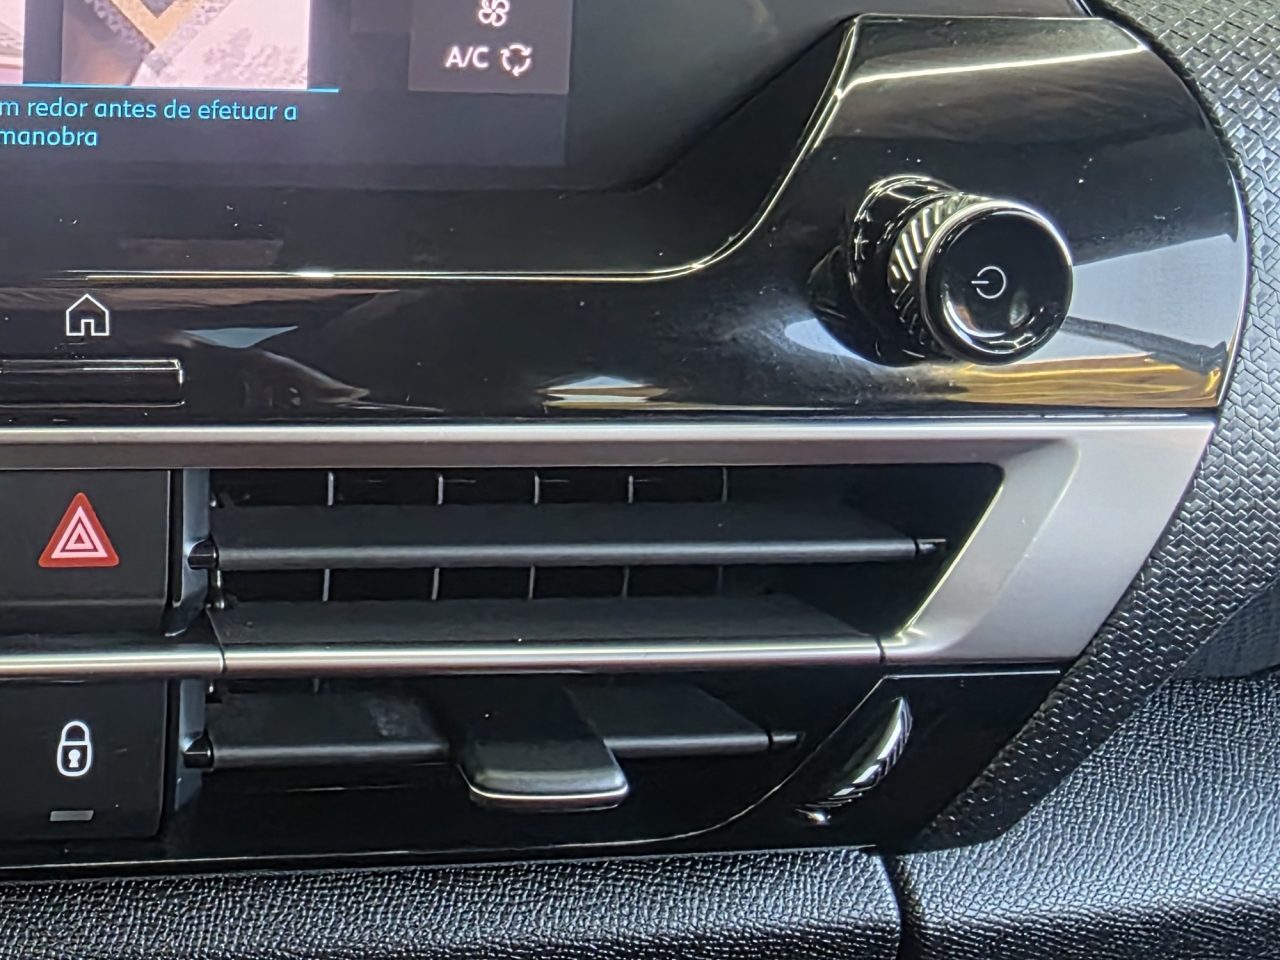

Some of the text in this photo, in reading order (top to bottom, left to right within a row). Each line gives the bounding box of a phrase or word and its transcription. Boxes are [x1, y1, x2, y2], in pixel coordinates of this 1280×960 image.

[445, 46, 489, 70] A/C
[27, 97, 87, 118] redor
[94, 100, 157, 119] antes
[163, 98, 191, 120] de
[197, 98, 277, 121] efetuar
[283, 103, 298, 121] a
